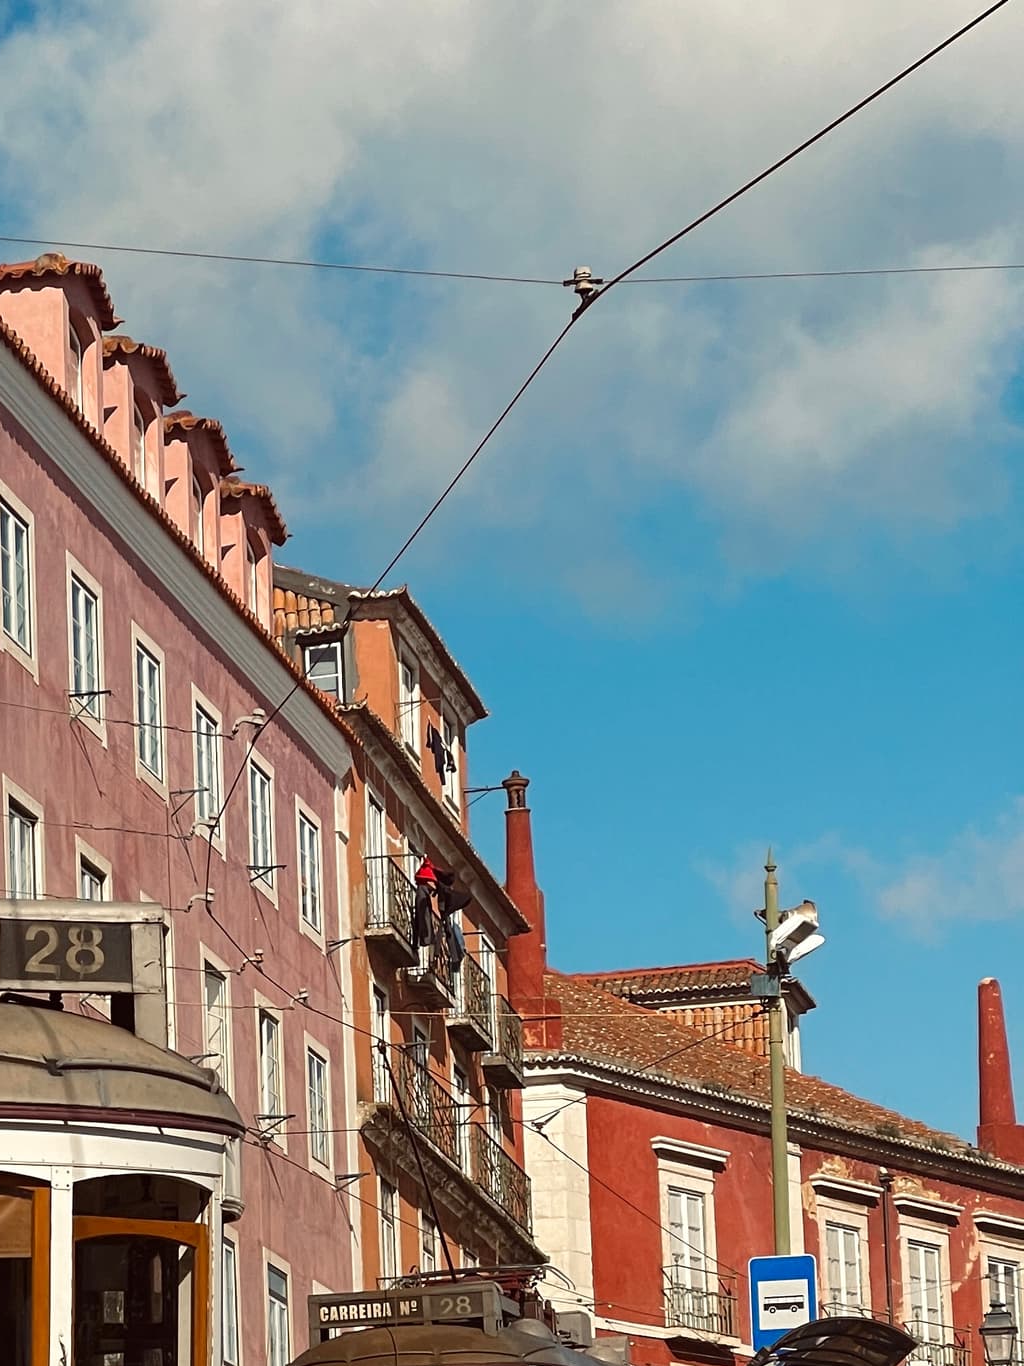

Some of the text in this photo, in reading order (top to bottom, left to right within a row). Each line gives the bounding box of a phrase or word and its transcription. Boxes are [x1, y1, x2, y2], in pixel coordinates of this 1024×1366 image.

[24, 925, 105, 974] 28
[319, 1302, 392, 1322] CARREIRA
[440, 1295, 472, 1315] 28
